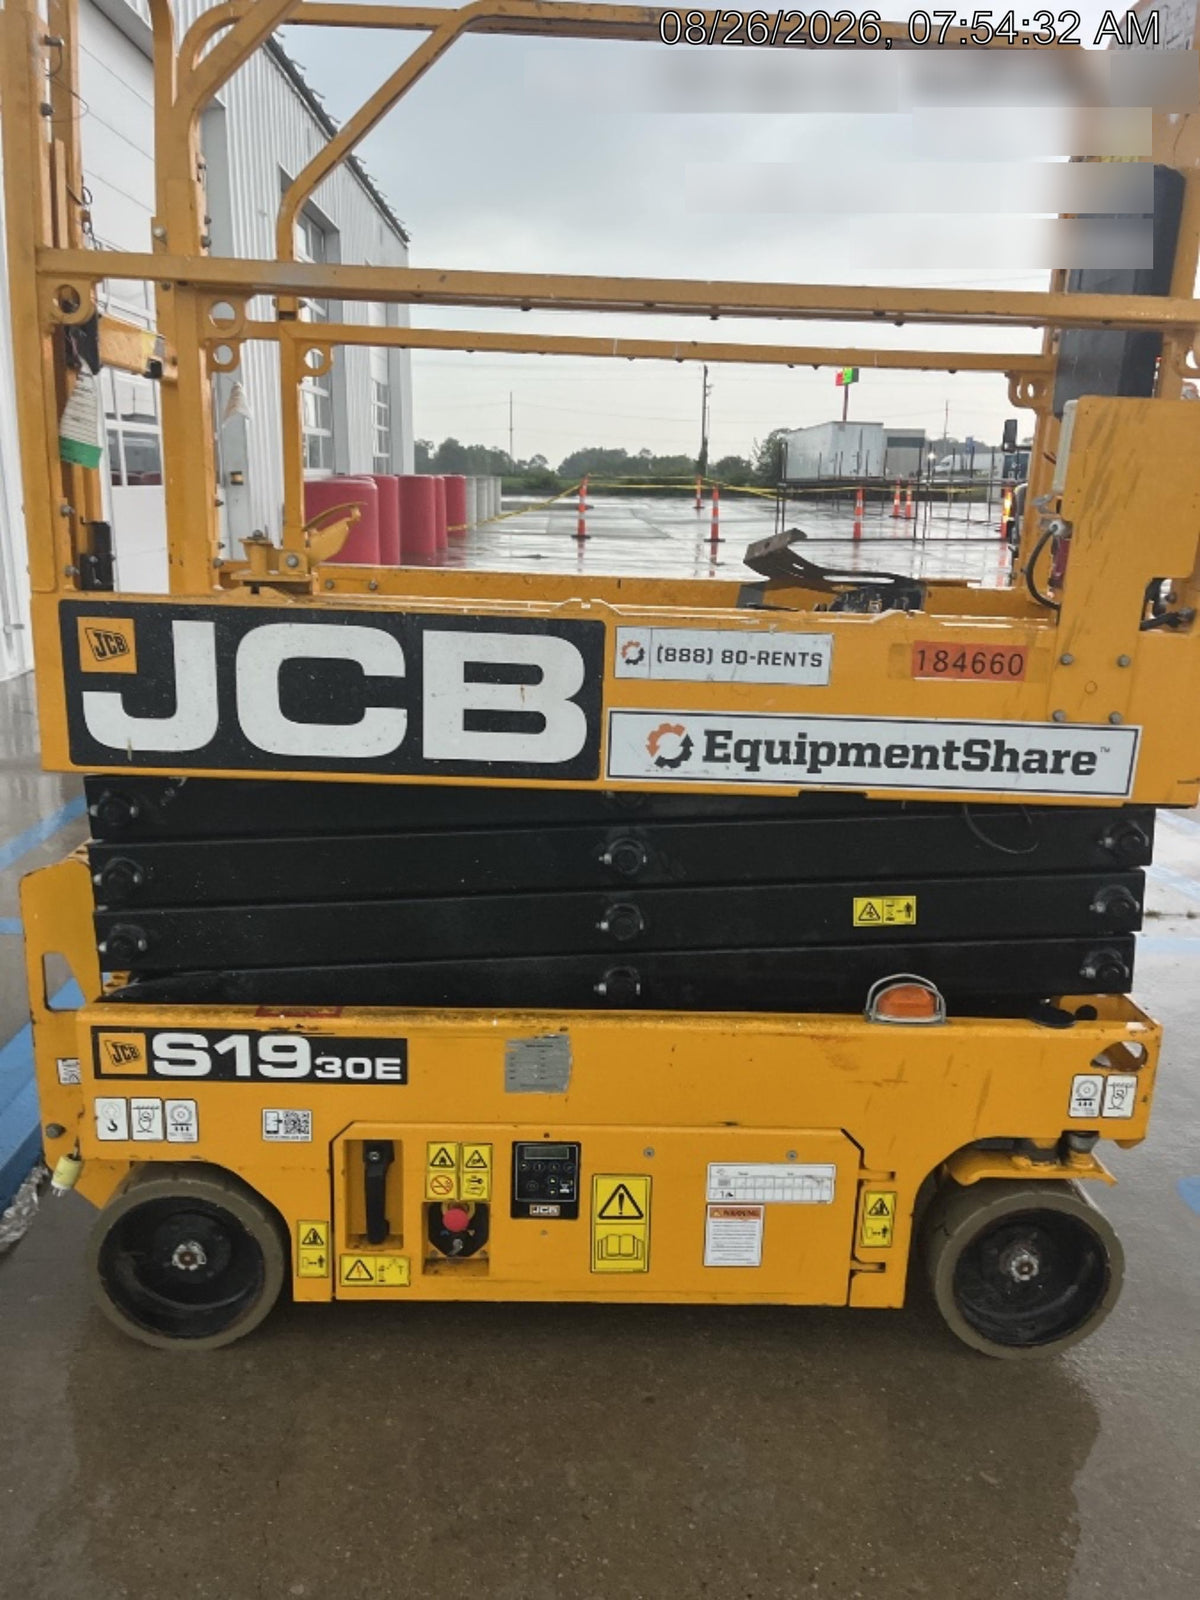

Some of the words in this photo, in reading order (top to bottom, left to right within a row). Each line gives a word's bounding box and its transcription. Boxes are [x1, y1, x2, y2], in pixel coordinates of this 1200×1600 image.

[92, 631, 127, 658] JCB
[657, 645, 714, 666] (888)
[721, 650, 823, 668] 80-RENTS
[918, 650, 1024, 676] 184660
[82, 619, 588, 764] JCB
[111, 1043, 139, 1063] JCB
